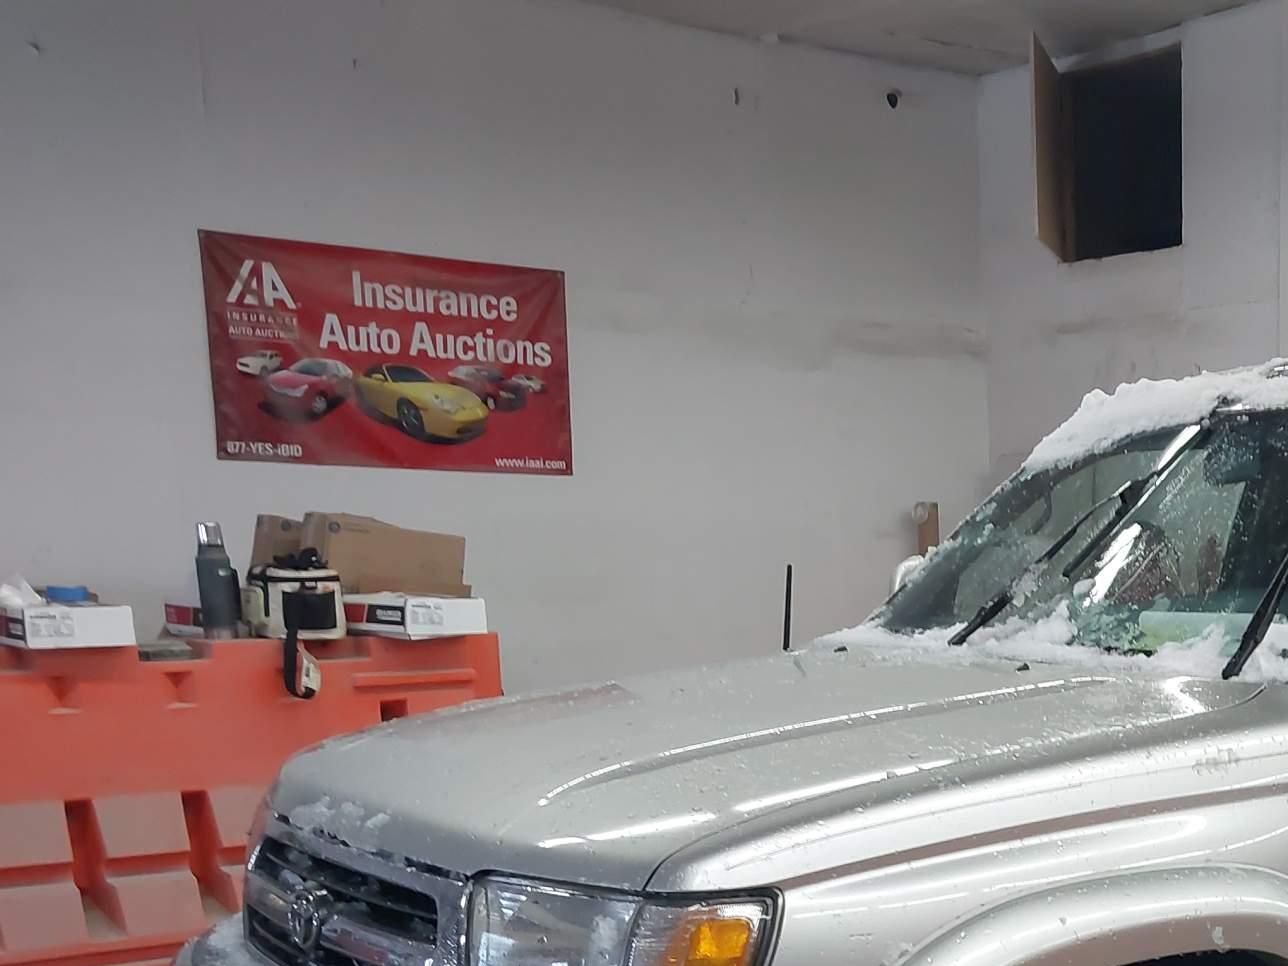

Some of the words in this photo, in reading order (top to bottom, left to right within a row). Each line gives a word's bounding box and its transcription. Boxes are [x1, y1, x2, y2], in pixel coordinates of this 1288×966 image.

[352, 270, 518, 321] Insurance
[227, 311, 297, 326] INSURAE
[228, 325, 253, 336] AUTO
[255, 328, 296, 339] AUCTI
[319, 313, 400, 355] Auto
[409, 321, 552, 367] Auctions
[494, 456, 567, 470] www.iaai.com
